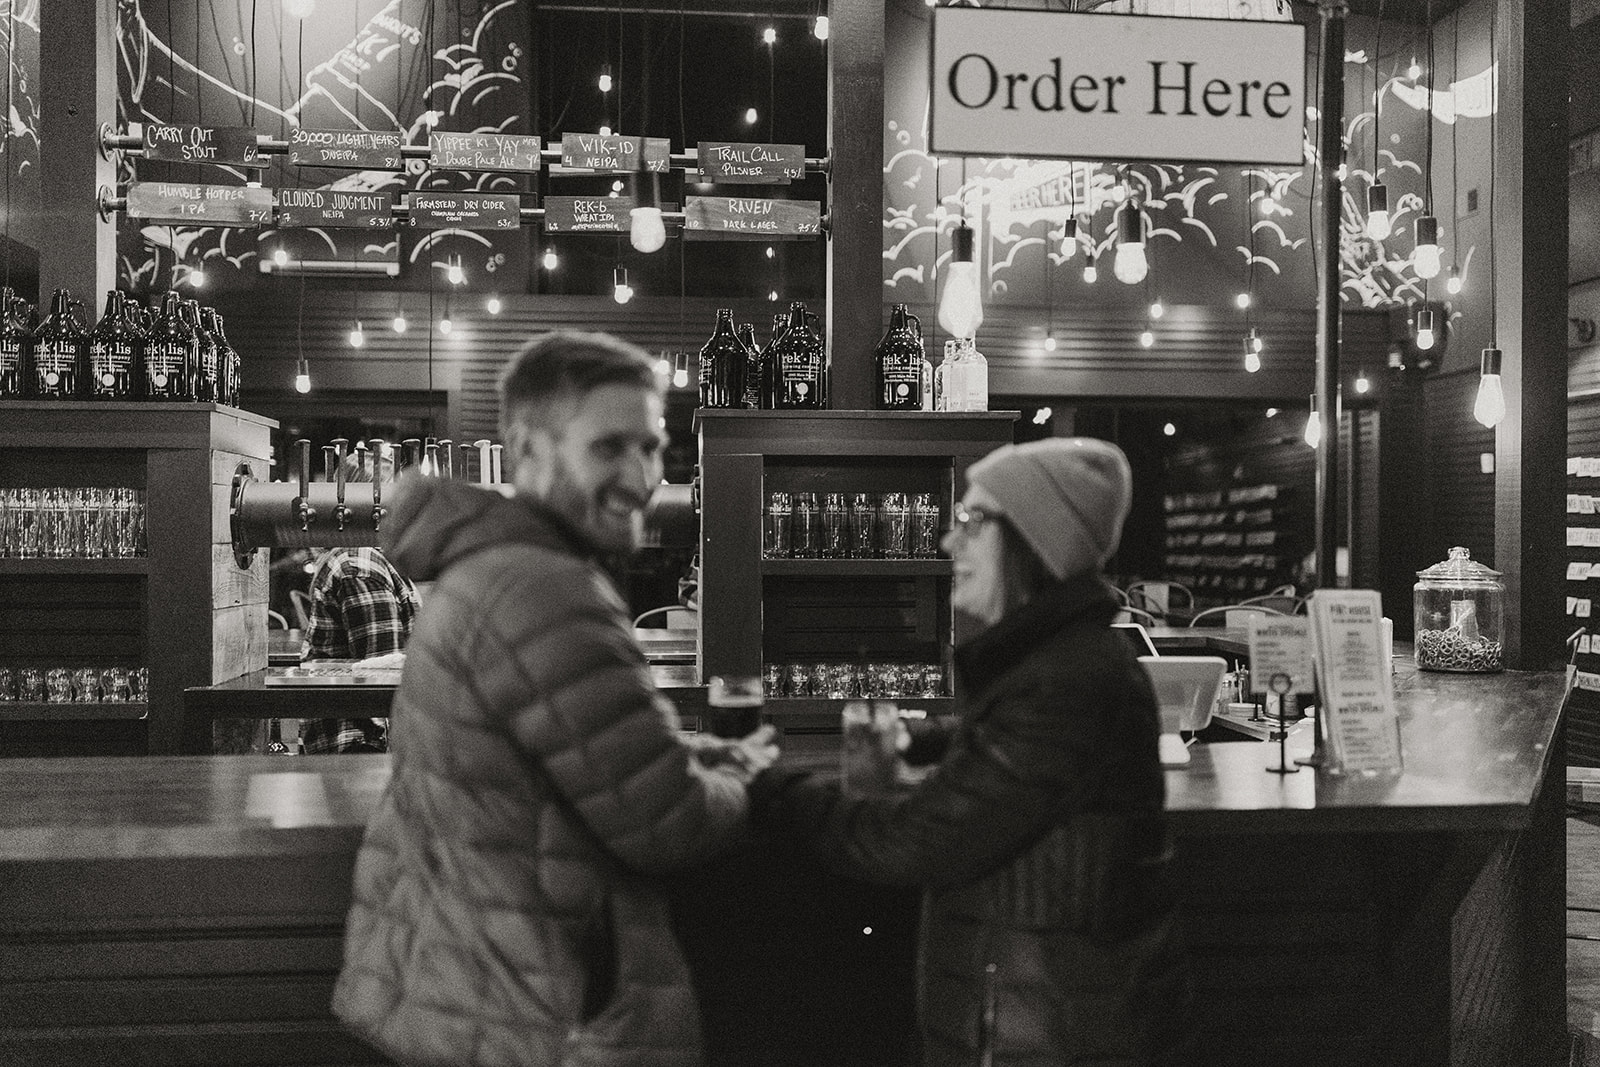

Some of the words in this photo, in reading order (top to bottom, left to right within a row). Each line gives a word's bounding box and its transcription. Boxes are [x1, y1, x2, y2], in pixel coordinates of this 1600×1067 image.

[947, 53, 1126, 113] Order
[1147, 60, 1293, 119] Here
[147, 125, 183, 148] CARRY
[191, 127, 214, 148] OUT
[292, 129, 332, 145] 30,000
[337, 132, 369, 146] LIGHT
[370, 133, 400, 150] YEARS
[434, 134, 472, 152] YIPPEE
[495, 136, 520, 156] YAY
[579, 136, 634, 155] WIK-ID
[182, 145, 217, 160] STOUT
[292, 152, 299, 163] 2
[710, 146, 750, 163] TRAIL
[751, 146, 784, 162] CALL
[385, 157, 398, 168] 8%
[431, 154, 438, 166] 3
[475, 151, 496, 169] PALE
[499, 155, 514, 169] ALE
[565, 155, 573, 167] 4
[586, 157, 618, 168] NEIPA
[648, 160, 665, 171] 7%
[722, 162, 763, 176] PILSNER
[159, 185, 202, 200] HUMBLE
[206, 188, 244, 200] HOPPER
[283, 190, 324, 208] CLOUDED
[332, 194, 385, 210] JUDGMENT
[464, 200, 479, 210] DRY
[482, 200, 505, 210] CIDER
[574, 200, 607, 213] REK-6
[728, 198, 773, 215] RAVEN
[250, 209, 268, 222] 7%
[322, 210, 345, 219] NEIPA
[599, 213, 615, 221] IPA
[370, 217, 390, 227] 5.3%
[410, 217, 417, 226] 8
[723, 220, 746, 230] DARK
[750, 220, 778, 230] LAGER
[60, 340, 76, 353] lis
[115, 341, 131, 355] lis
[168, 343, 184, 355] lis
